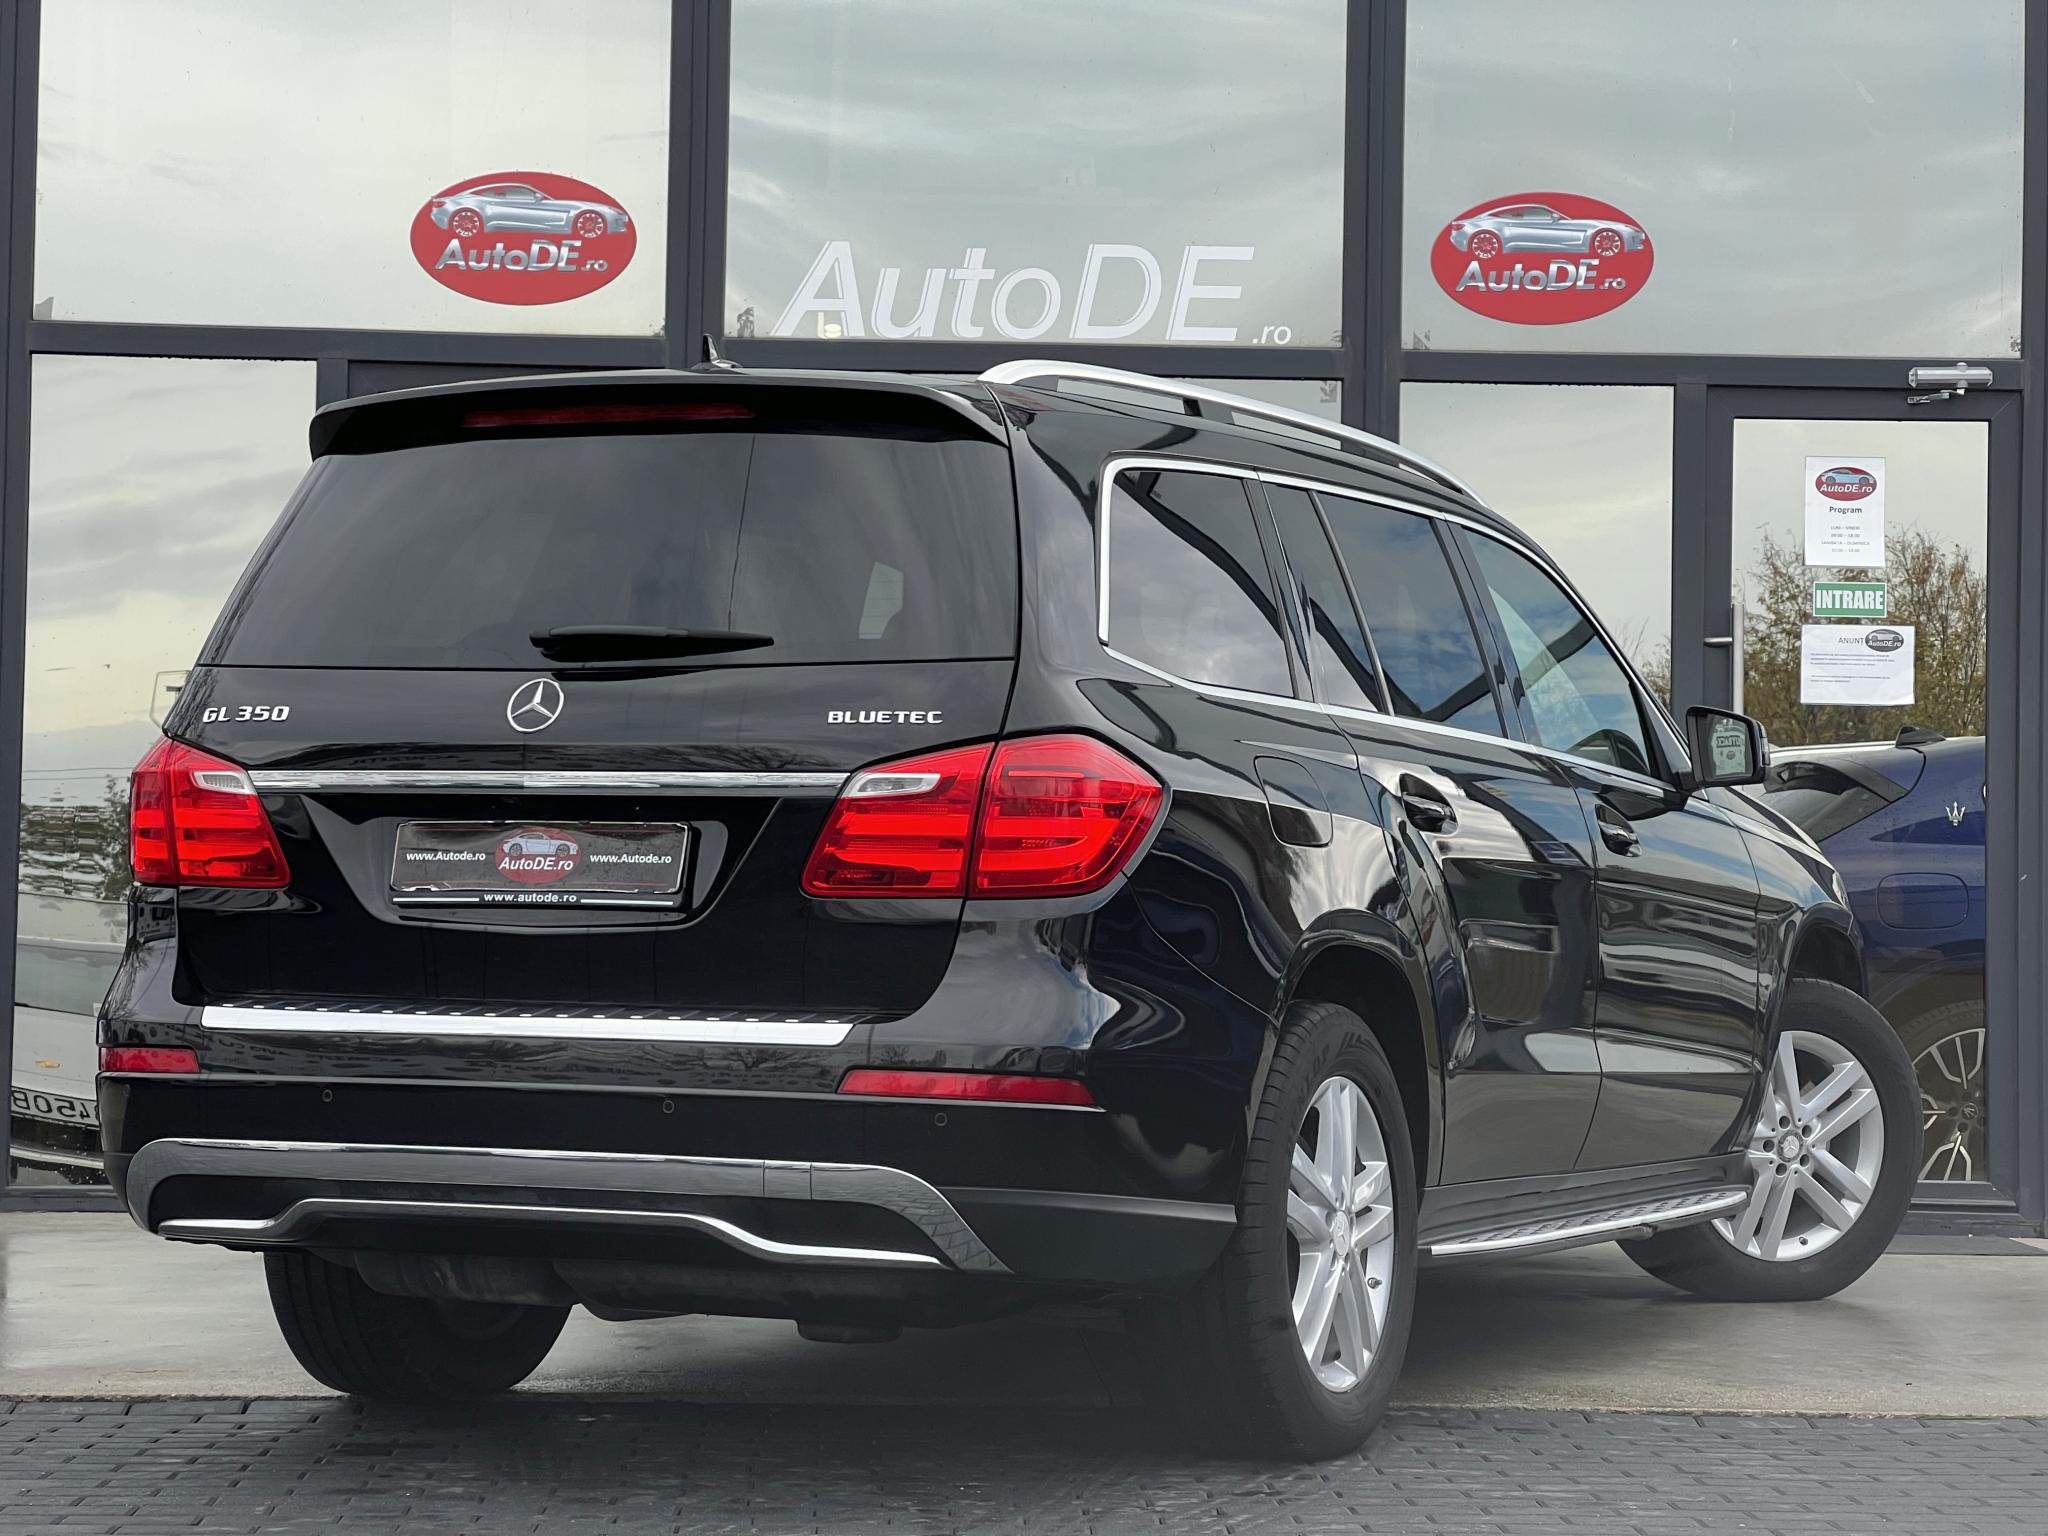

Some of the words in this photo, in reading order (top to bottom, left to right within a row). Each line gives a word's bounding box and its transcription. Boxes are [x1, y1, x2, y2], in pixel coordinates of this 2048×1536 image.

[1820, 483, 1873, 493] AutoDE.ro
[1829, 506, 1862, 515] Program
[1816, 590, 1884, 609] INTRARE
[202, 707, 231, 723] GL
[235, 705, 290, 721] 350
[827, 710, 943, 724] BLUETEC
[405, 851, 487, 862] www.Autode.ro
[589, 853, 673, 864] www.Autode.ro
[498, 857, 574, 871] AutoDE.ro
[484, 892, 577, 904] www.autode.ro
